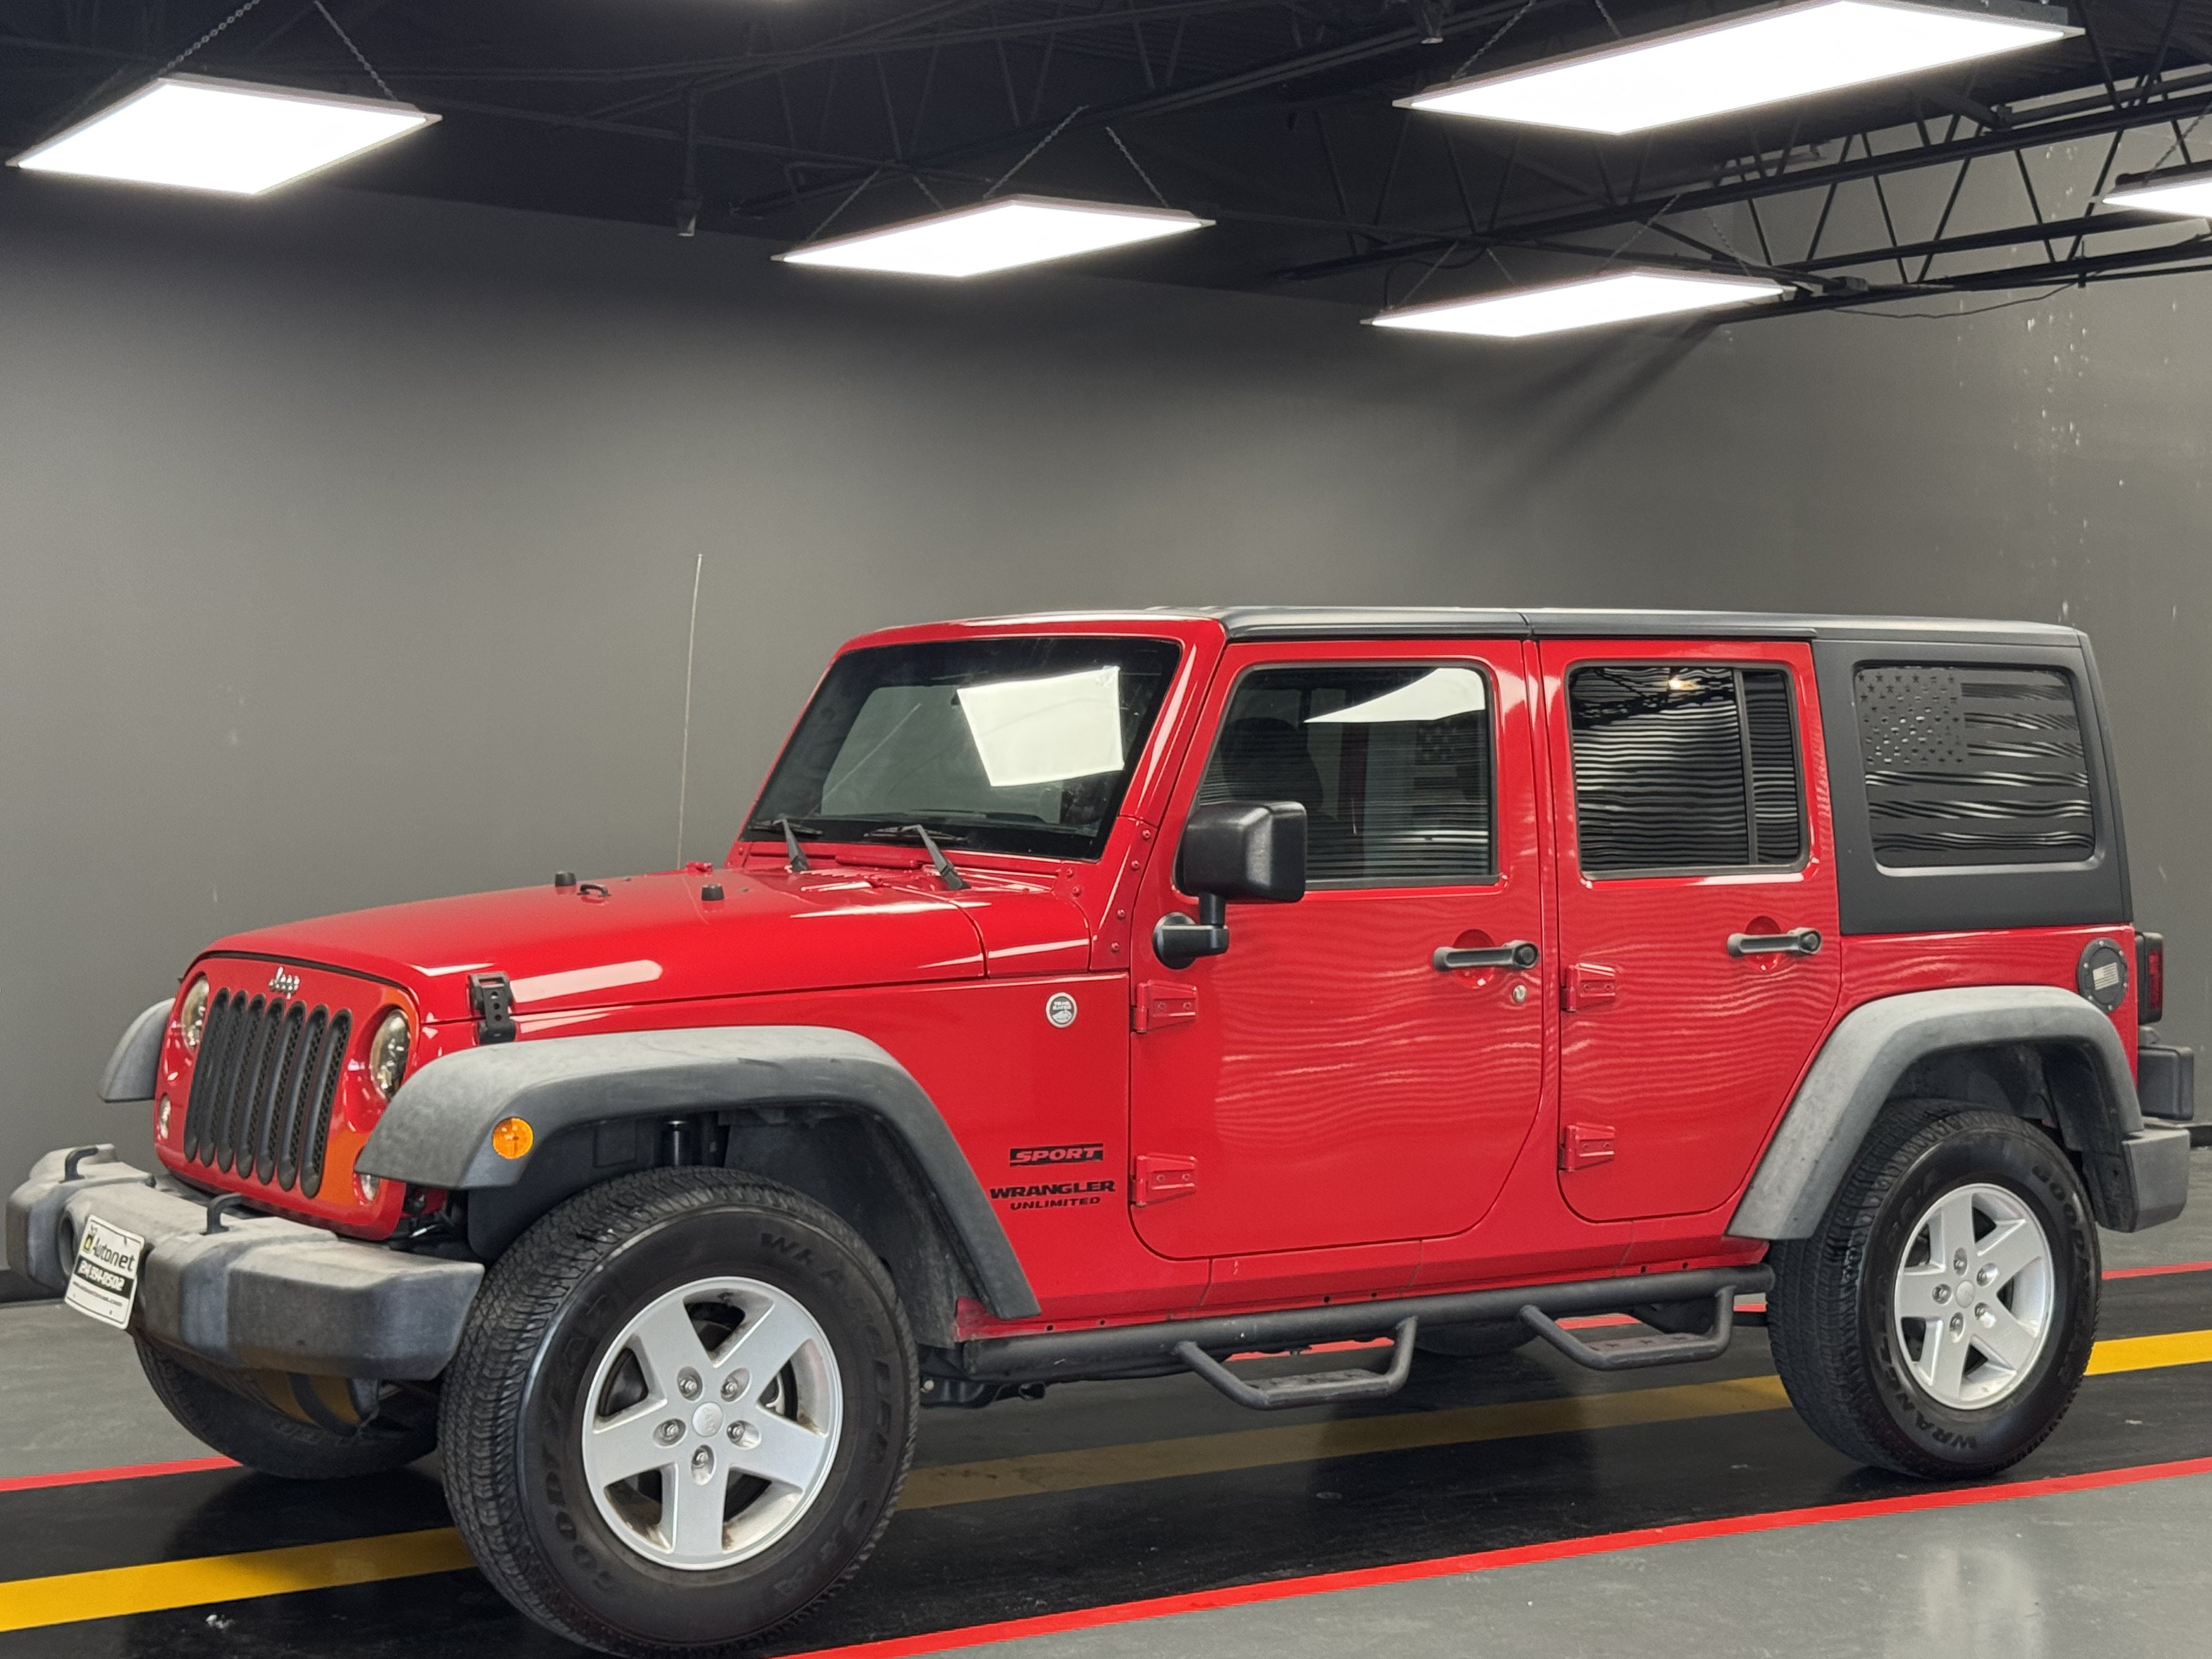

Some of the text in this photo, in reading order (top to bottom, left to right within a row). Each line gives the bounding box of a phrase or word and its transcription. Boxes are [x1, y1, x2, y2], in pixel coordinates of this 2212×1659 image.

[1011, 1147, 1103, 1164] SPORT
[990, 1181, 1116, 1199] WRANGLER
[1010, 1197, 1101, 1211] UNLIMITED
